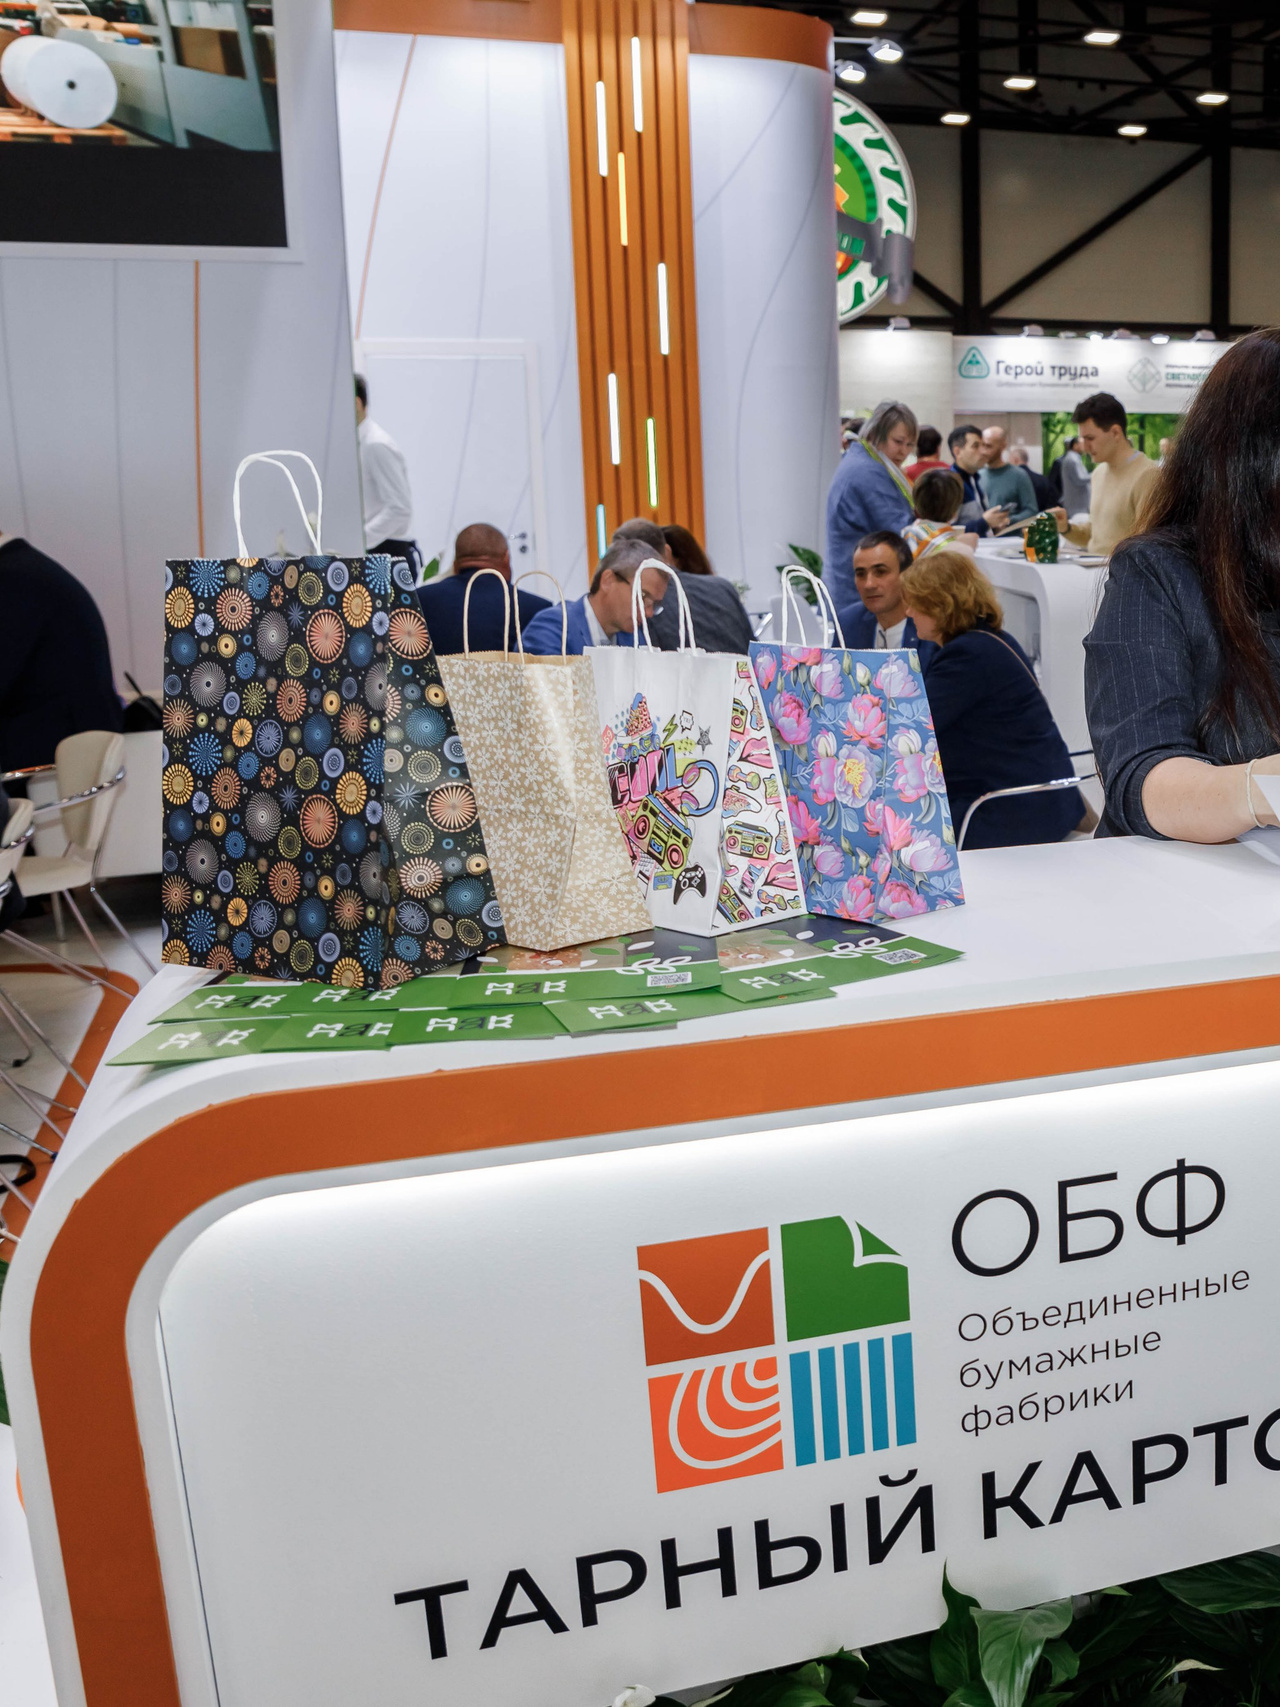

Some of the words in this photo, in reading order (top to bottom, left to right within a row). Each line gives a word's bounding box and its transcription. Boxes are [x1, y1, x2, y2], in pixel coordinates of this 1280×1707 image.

[996, 361, 1044, 379] Герой
[1050, 365, 1099, 380] труда
[952, 1158, 1226, 1277] ОБФ
[958, 1270, 1250, 1341] Объединенные
[959, 1331, 1161, 1390] бумажные
[961, 1379, 1134, 1437] фабрики
[394, 1468, 936, 1661] ТАРНЫЙ
